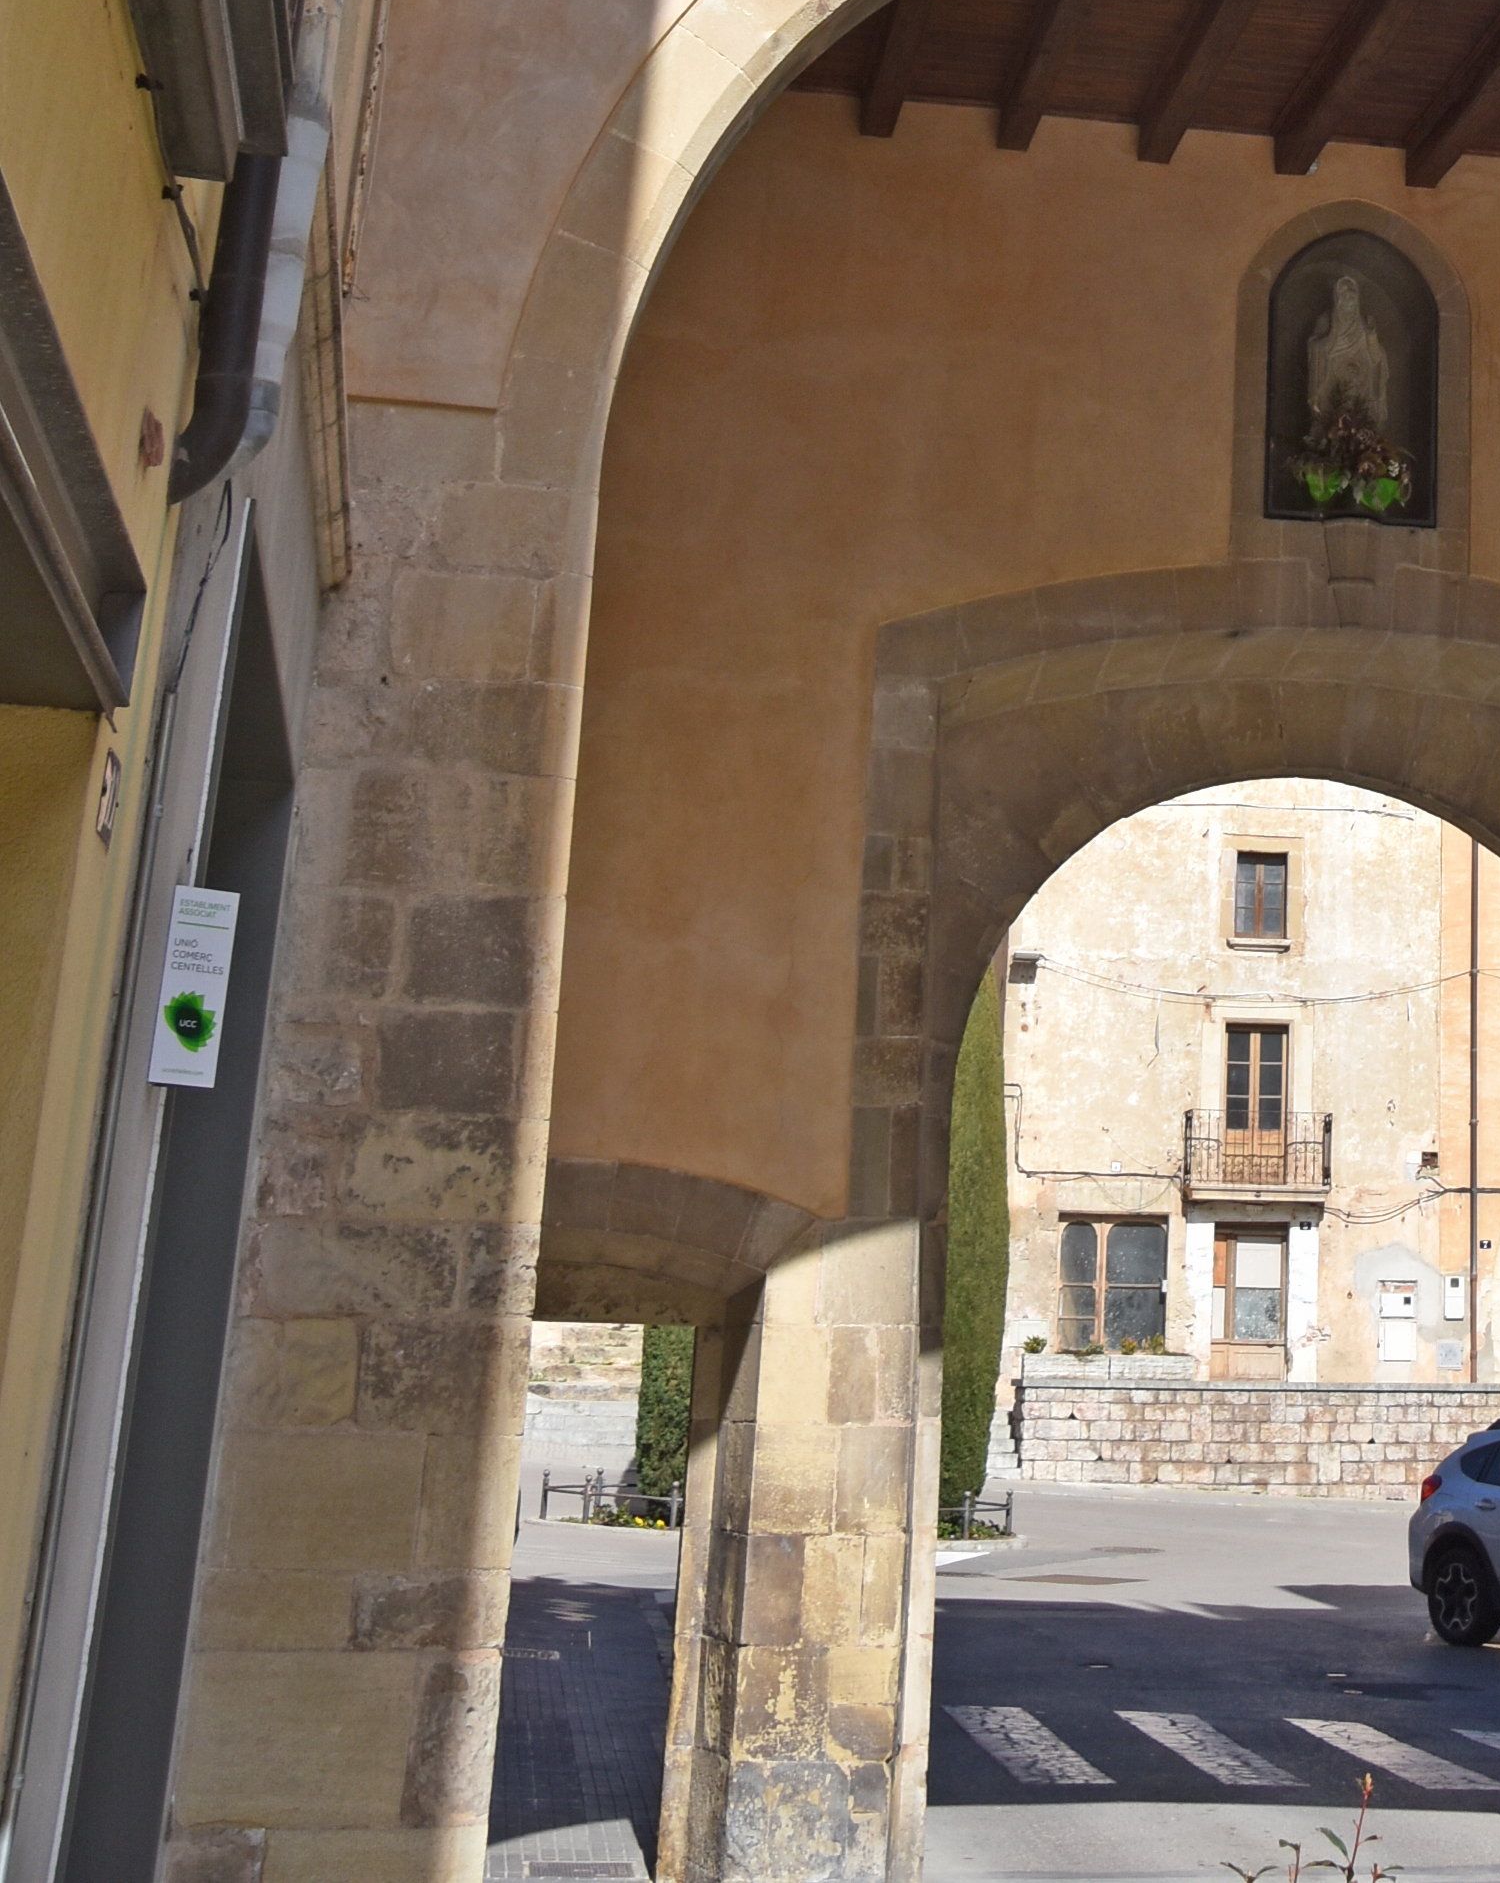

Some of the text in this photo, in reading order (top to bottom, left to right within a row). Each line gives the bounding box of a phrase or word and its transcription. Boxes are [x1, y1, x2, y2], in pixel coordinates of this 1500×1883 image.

[180, 899, 231, 911] ESTABLIMENT
[179, 908, 217, 918] ASSOCIAT
[174, 937, 198, 948] UNIÓ
[171, 961, 224, 975] CENTELLES
[179, 1019, 198, 1028] UCC
[1482, 1240, 1489, 1249] 7
